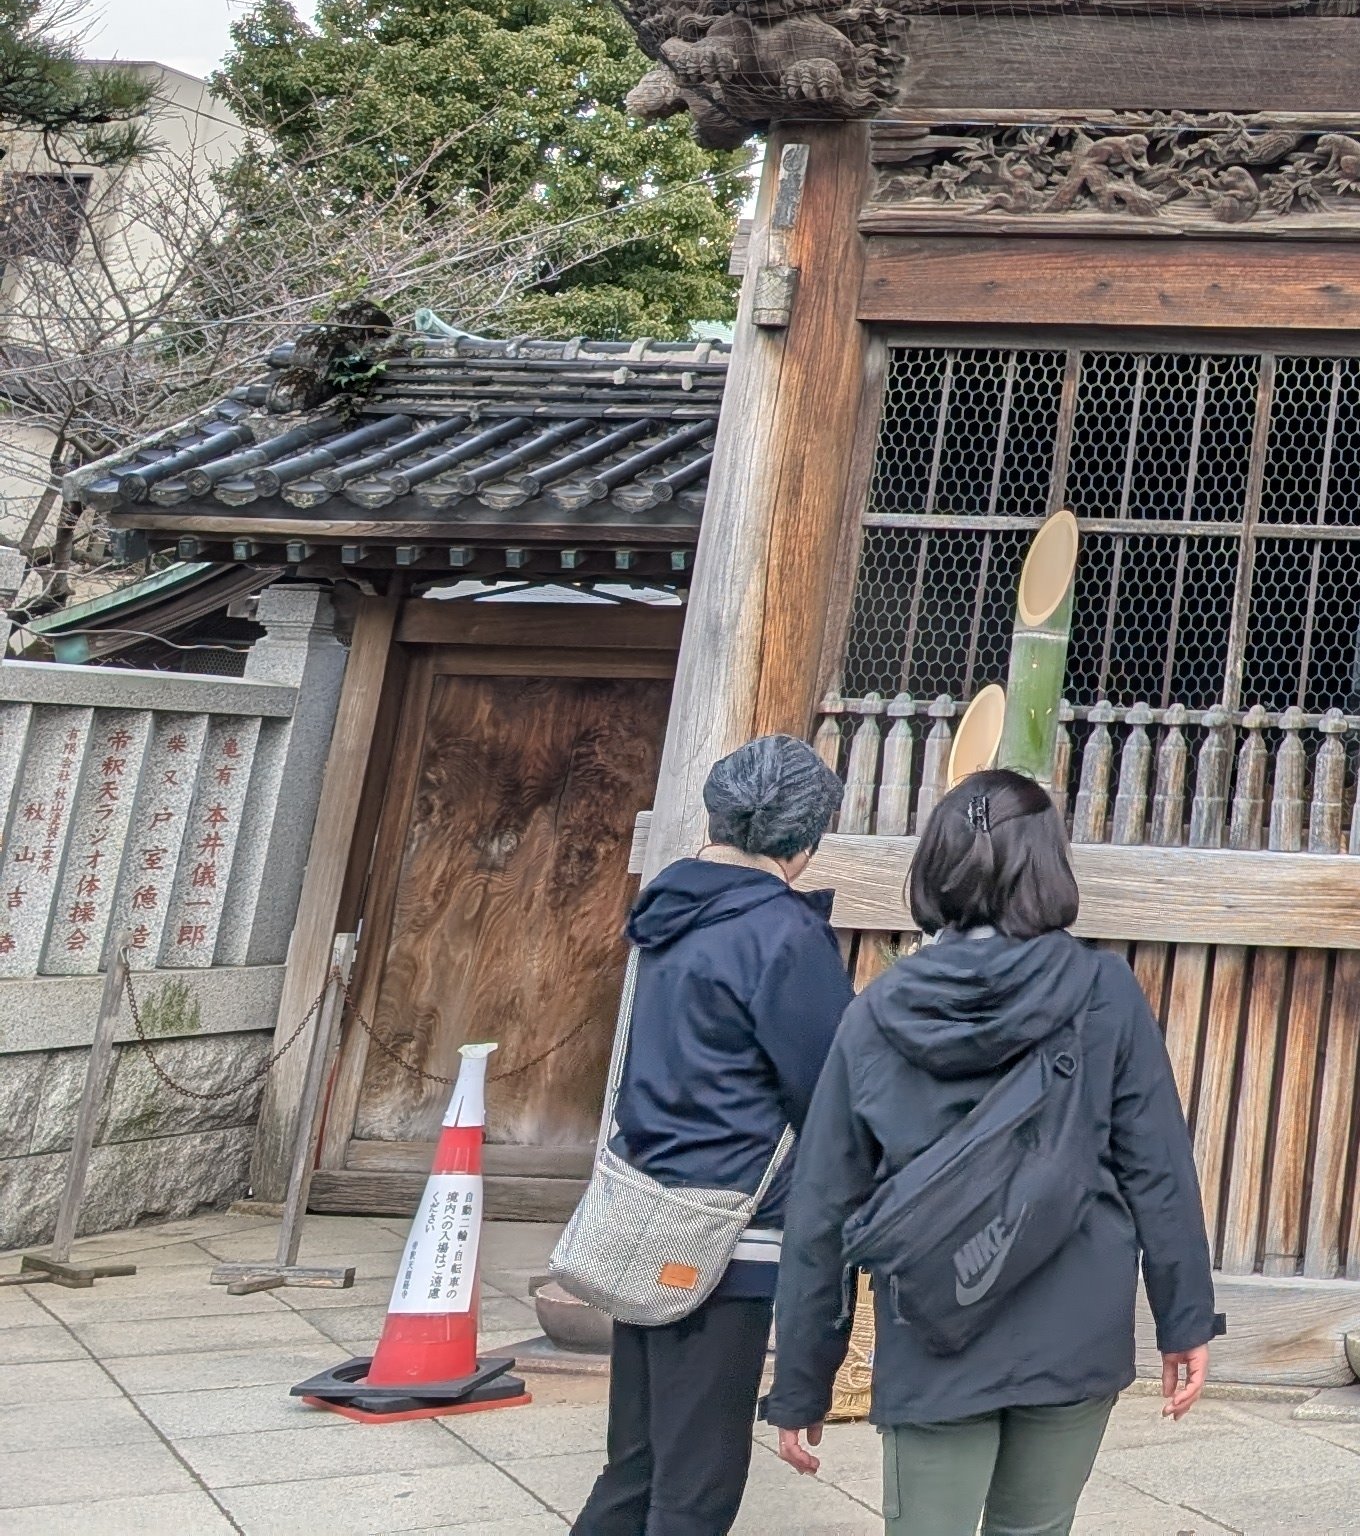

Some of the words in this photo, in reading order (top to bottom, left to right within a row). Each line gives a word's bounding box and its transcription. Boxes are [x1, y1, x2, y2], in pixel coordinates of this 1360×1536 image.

[64, 729, 132, 951] 帝釈天ラジオ体操会
[425, 1191, 440, 1233] ください
[428, 1191, 459, 1300] 境内への入場はご遠慮
[446, 1191, 473, 1300] 自動二輪・自転車の
[952, 1215, 1007, 1284] NIKE
